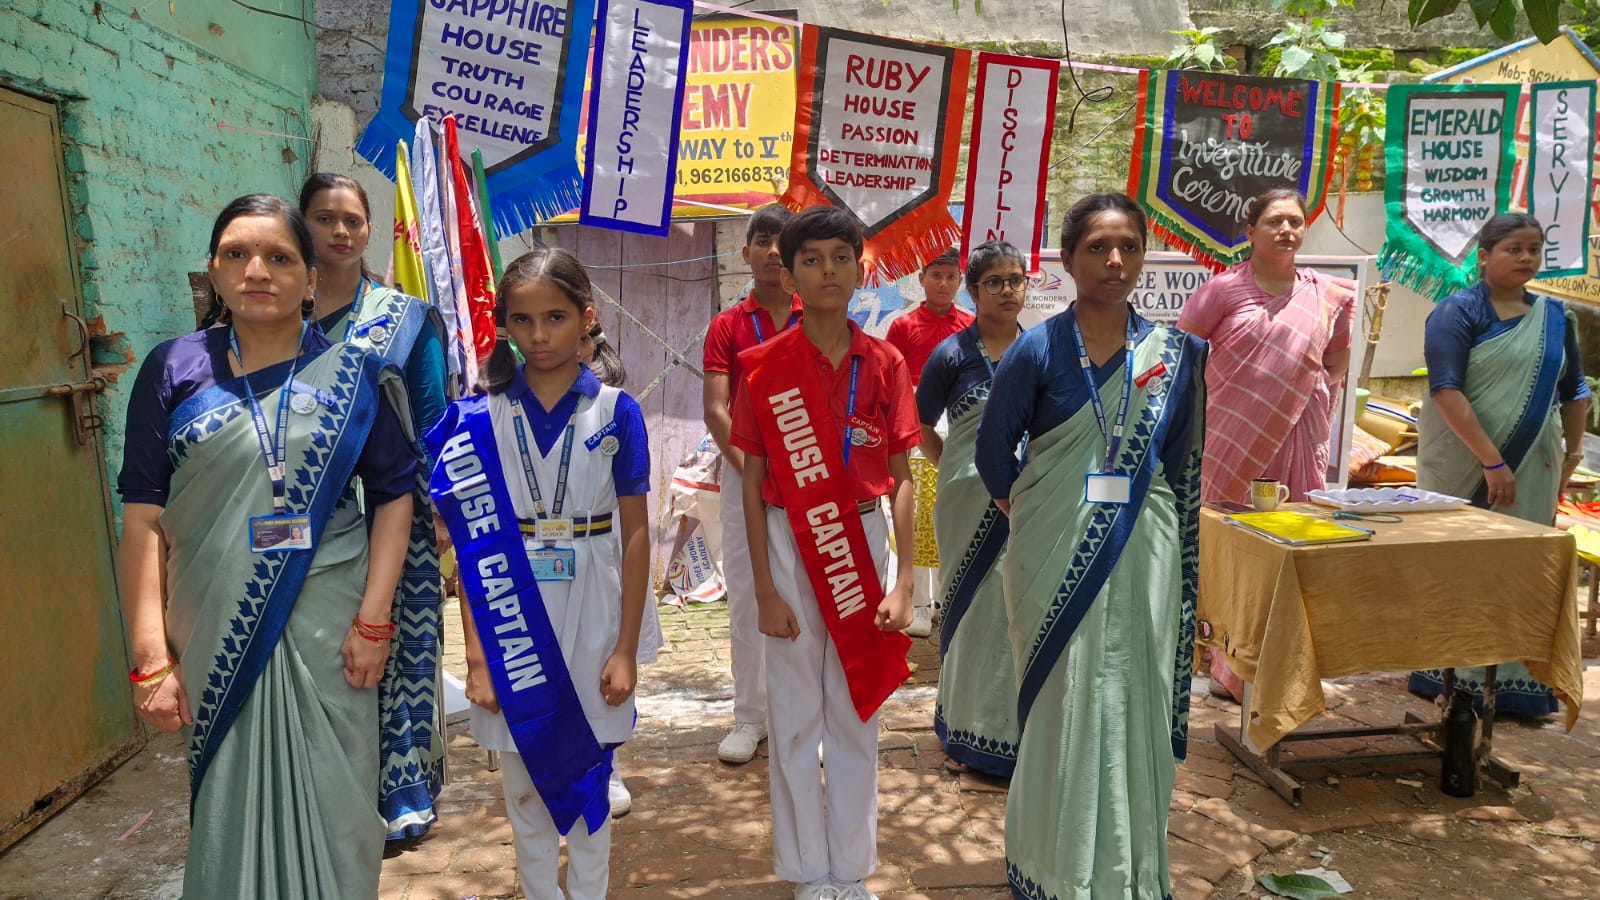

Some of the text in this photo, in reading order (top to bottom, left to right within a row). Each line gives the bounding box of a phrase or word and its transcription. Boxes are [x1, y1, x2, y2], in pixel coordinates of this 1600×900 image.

[441, 22, 542, 66] HOUSE
[690, 26, 793, 73] NDERS
[440, 56, 525, 90] TRUTH
[845, 54, 931, 93] RUBY
[432, 81, 545, 121] COURAGE
[843, 93, 917, 121] HOUSE
[1179, 77, 1304, 118] WELCOME
[422, 104, 543, 145] EXCELLENCE
[613, 7, 650, 219] LEADERSHIP
[1221, 113, 1253, 140] TO
[1410, 108, 1501, 136] EMERALD
[840, 122, 919, 146] PASSION
[733, 138, 755, 159] to
[820, 149, 934, 171] DETERMINATION
[986, 68, 1023, 241] DISCIPLIN
[1178, 129, 1303, 181] Investiture
[1421, 140, 1483, 160] HOUSE
[825, 170, 917, 191] LEADERSHIP
[1424, 166, 1488, 183] WISDOM
[1544, 89, 1569, 271] SERVICE
[1420, 187, 1486, 203] GROWTH
[1423, 206, 1490, 223] HARMONY
[1131, 292, 1193, 310] ACAD
[587, 421, 617, 446] CAPTAIN
[851, 416, 880, 434] CAPTAIN
[769, 387, 867, 620] HOUSE CAPTAIN
[442, 431, 500, 539] HOUSE
[477, 552, 548, 694] CAPTAIN
